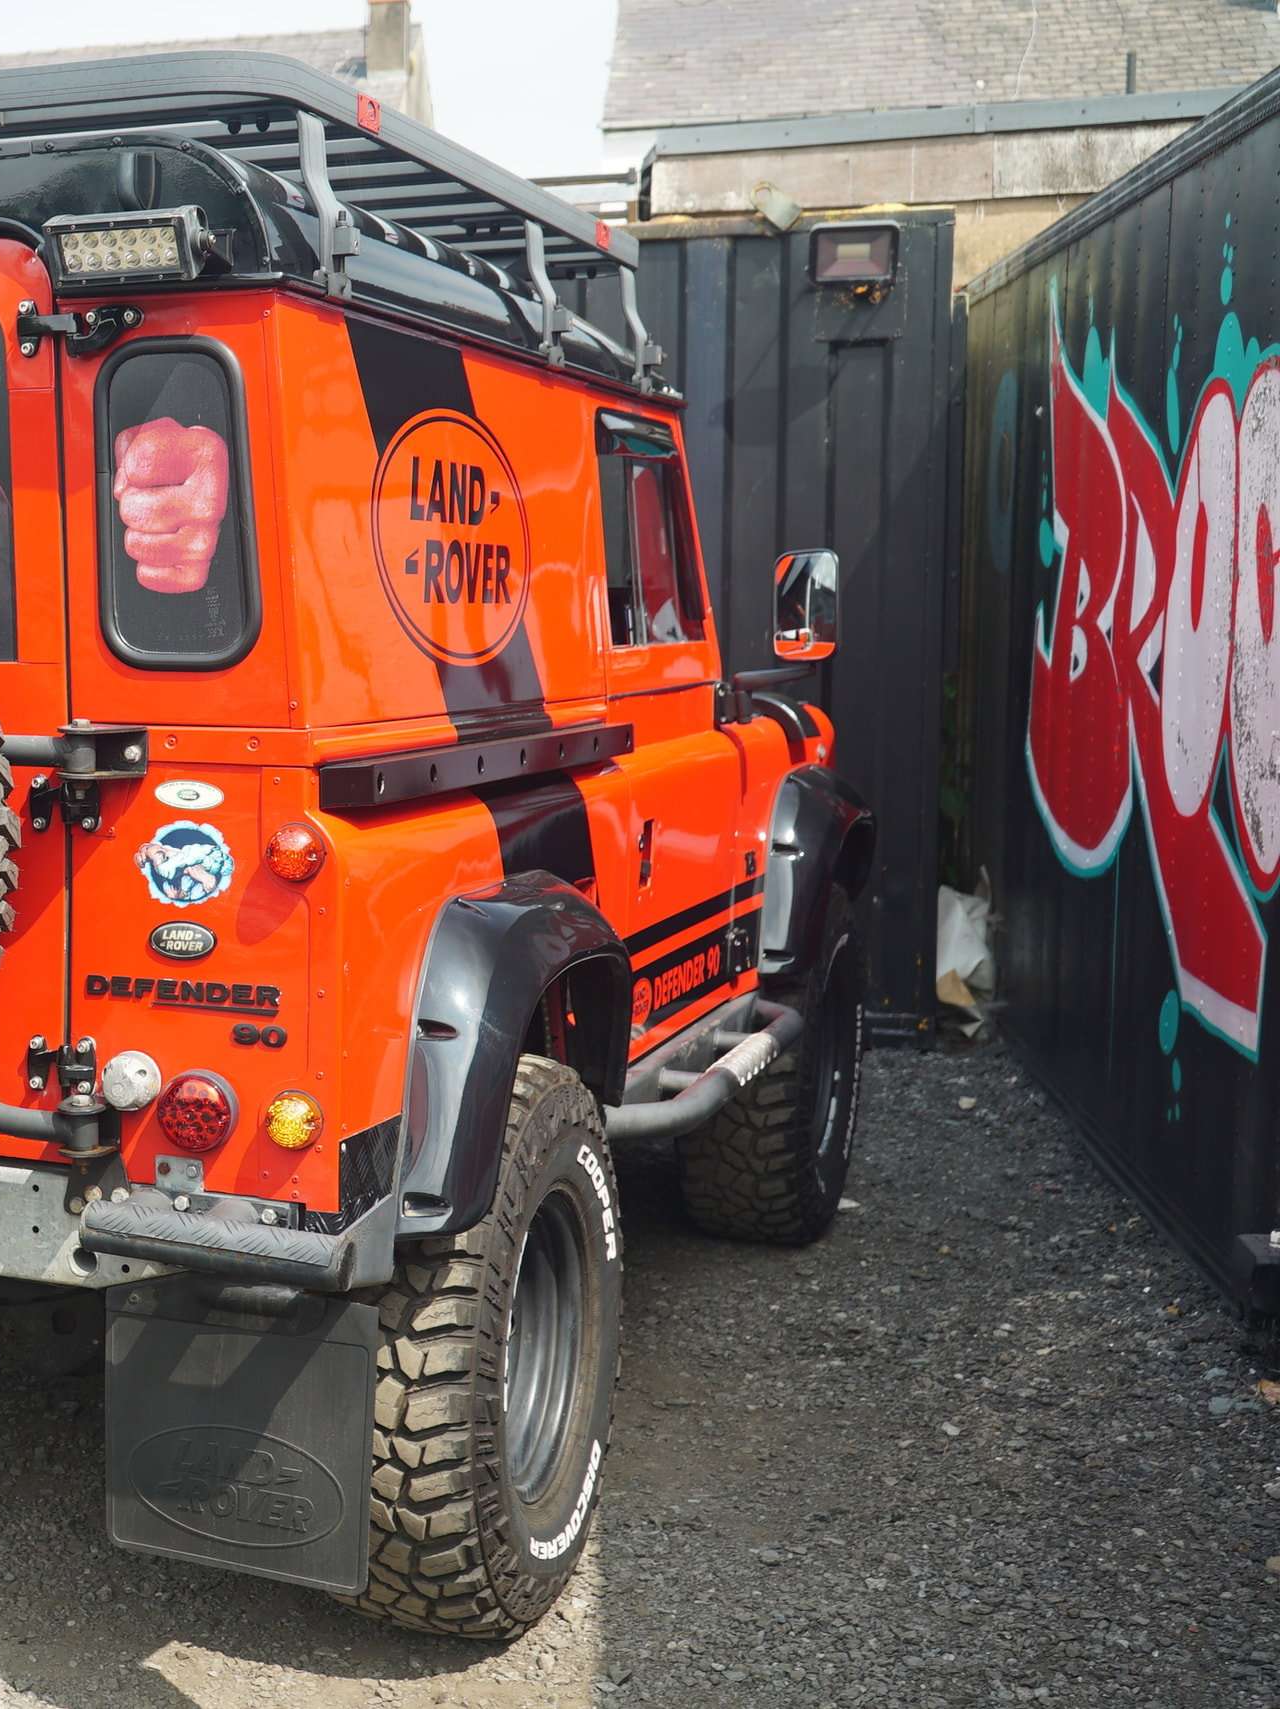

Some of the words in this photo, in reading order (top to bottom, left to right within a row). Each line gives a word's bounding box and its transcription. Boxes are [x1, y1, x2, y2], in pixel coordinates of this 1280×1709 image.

[410, 455, 486, 526] LAND
[423, 538, 512, 604] ROVER
[162, 929, 194, 941] LAND
[166, 940, 205, 952] ROVER
[85, 974, 281, 1007] DEFENDER
[653, 952, 705, 1012] DEFENDER
[706, 943, 721, 980] 90
[232, 1022, 288, 1048] 90
[576, 1144, 618, 1262] COOPER
[176, 1477, 315, 1533] ROVER
[529, 1439, 602, 1560] DISCOVERER
